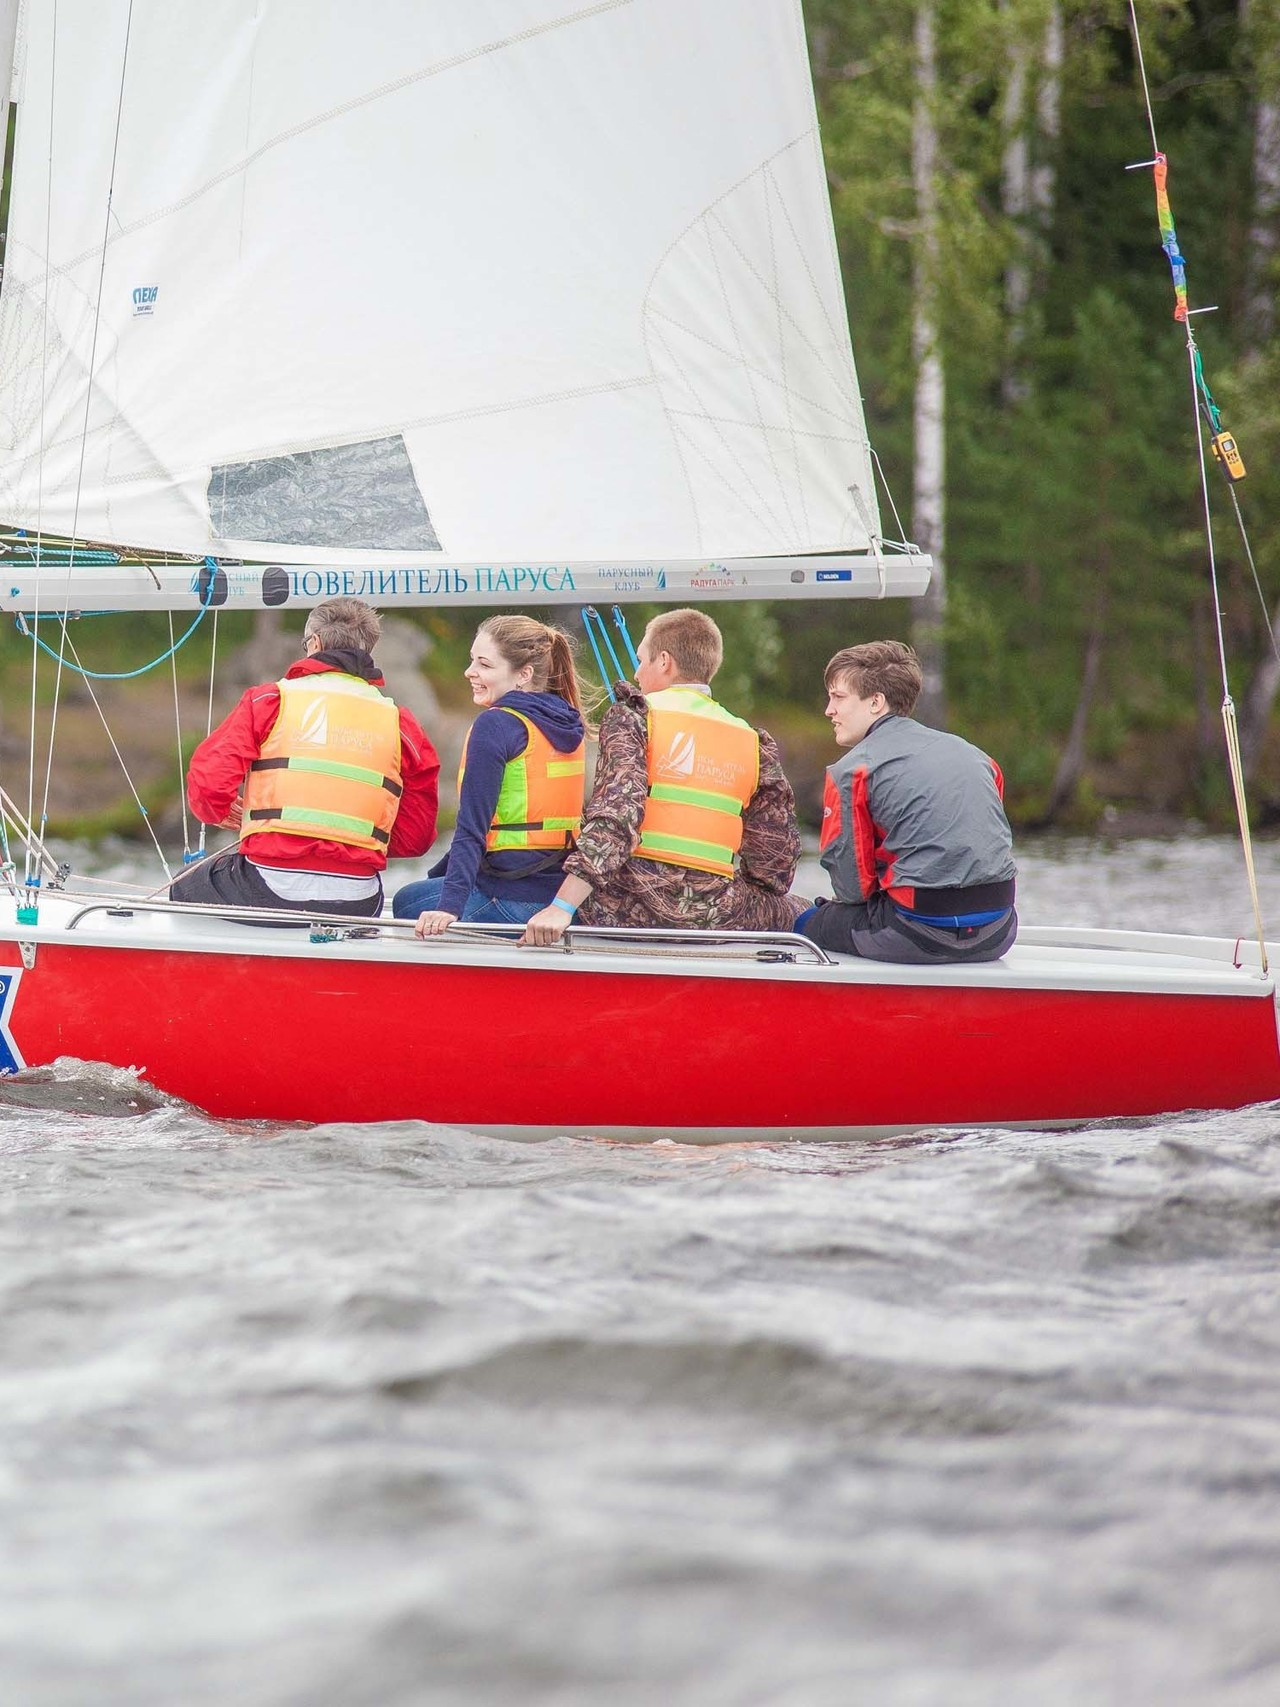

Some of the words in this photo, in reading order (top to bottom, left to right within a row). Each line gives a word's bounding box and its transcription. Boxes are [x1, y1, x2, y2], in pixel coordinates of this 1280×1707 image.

[598, 566, 653, 578] ПАРУСНЫЙ
[475, 567, 576, 592] ПАРУСА
[614, 582, 640, 592] КЛУБ
